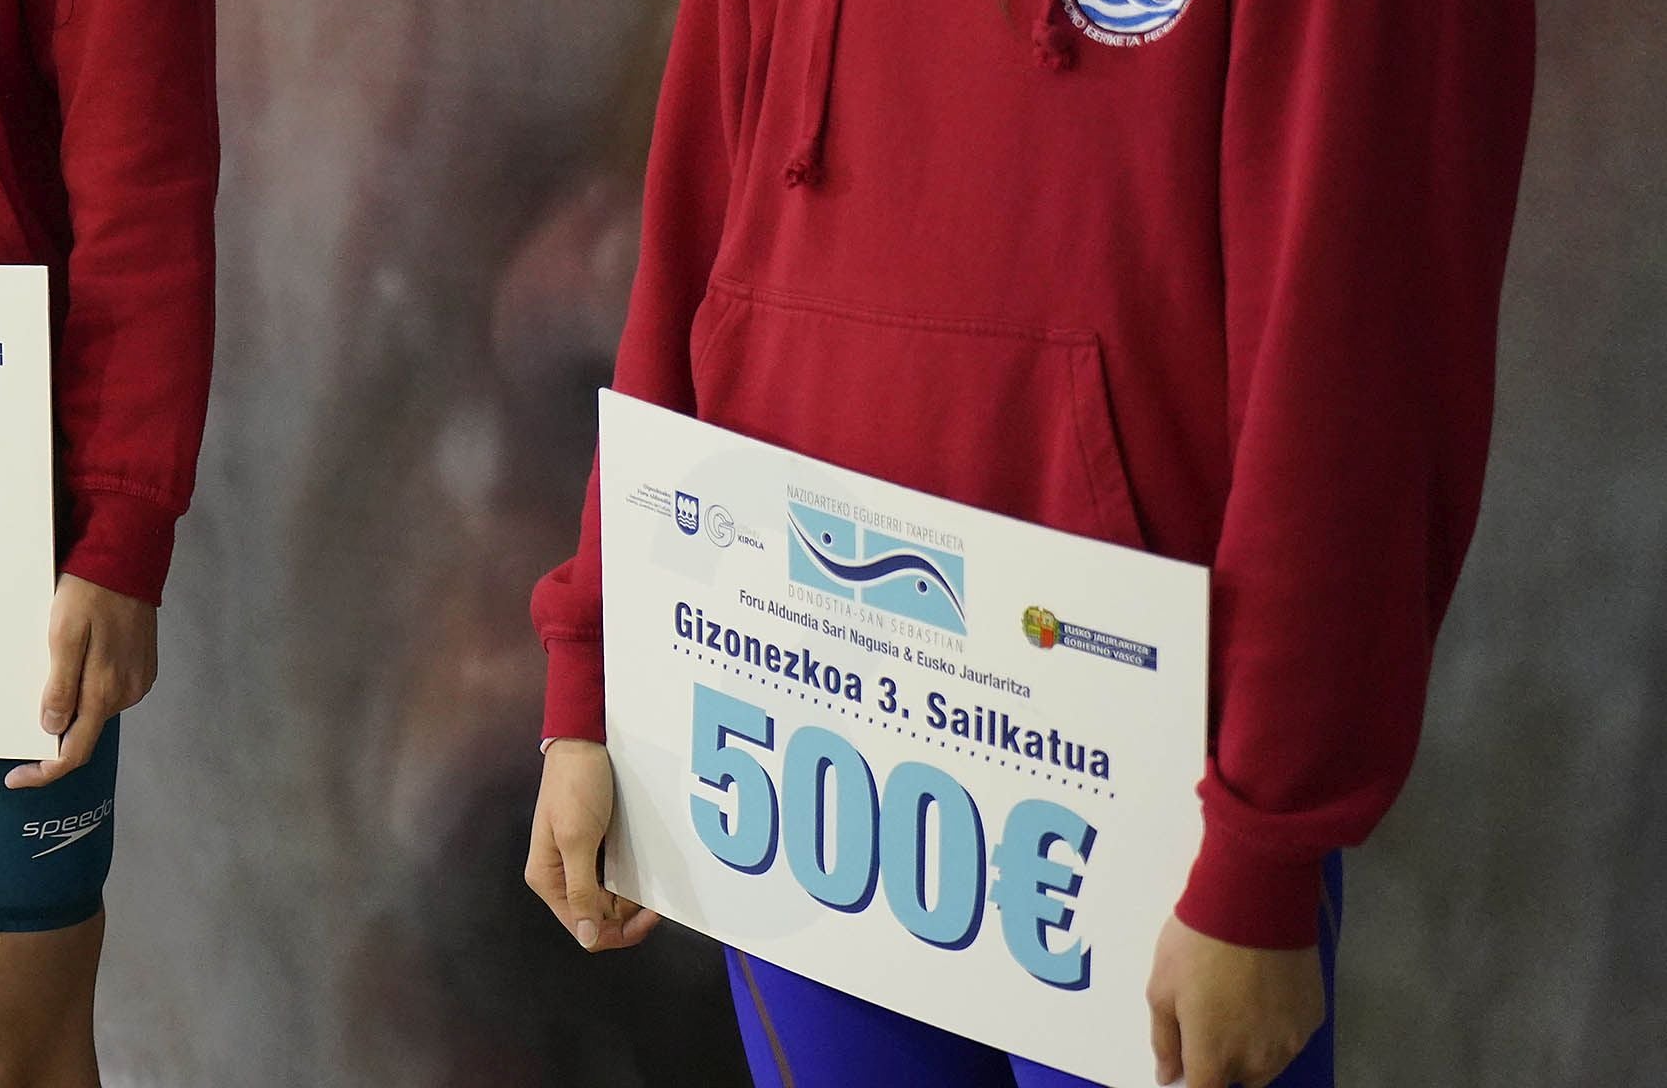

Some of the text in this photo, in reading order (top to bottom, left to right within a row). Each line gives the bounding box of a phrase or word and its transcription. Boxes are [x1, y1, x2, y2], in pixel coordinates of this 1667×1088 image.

[737, 534, 765, 551] KIROLA
[786, 484, 965, 553] NAZIOARTEKO EGUBERRI TXAPELKETA
[739, 589, 1031, 699] Foru Aldundia Sari Nagusia & Eusko Jaurlaritza
[788, 584, 964, 654] DONOSTIA-SAN SEBASTIAN
[1063, 636, 1143, 667] GOBIERNO VASCO
[1064, 624, 1150, 656] EUSKO JAURLARITZA
[674, 601, 1110, 781] Gizonezkoa 3. Sailkatua
[690, 681, 1098, 992] 500€
